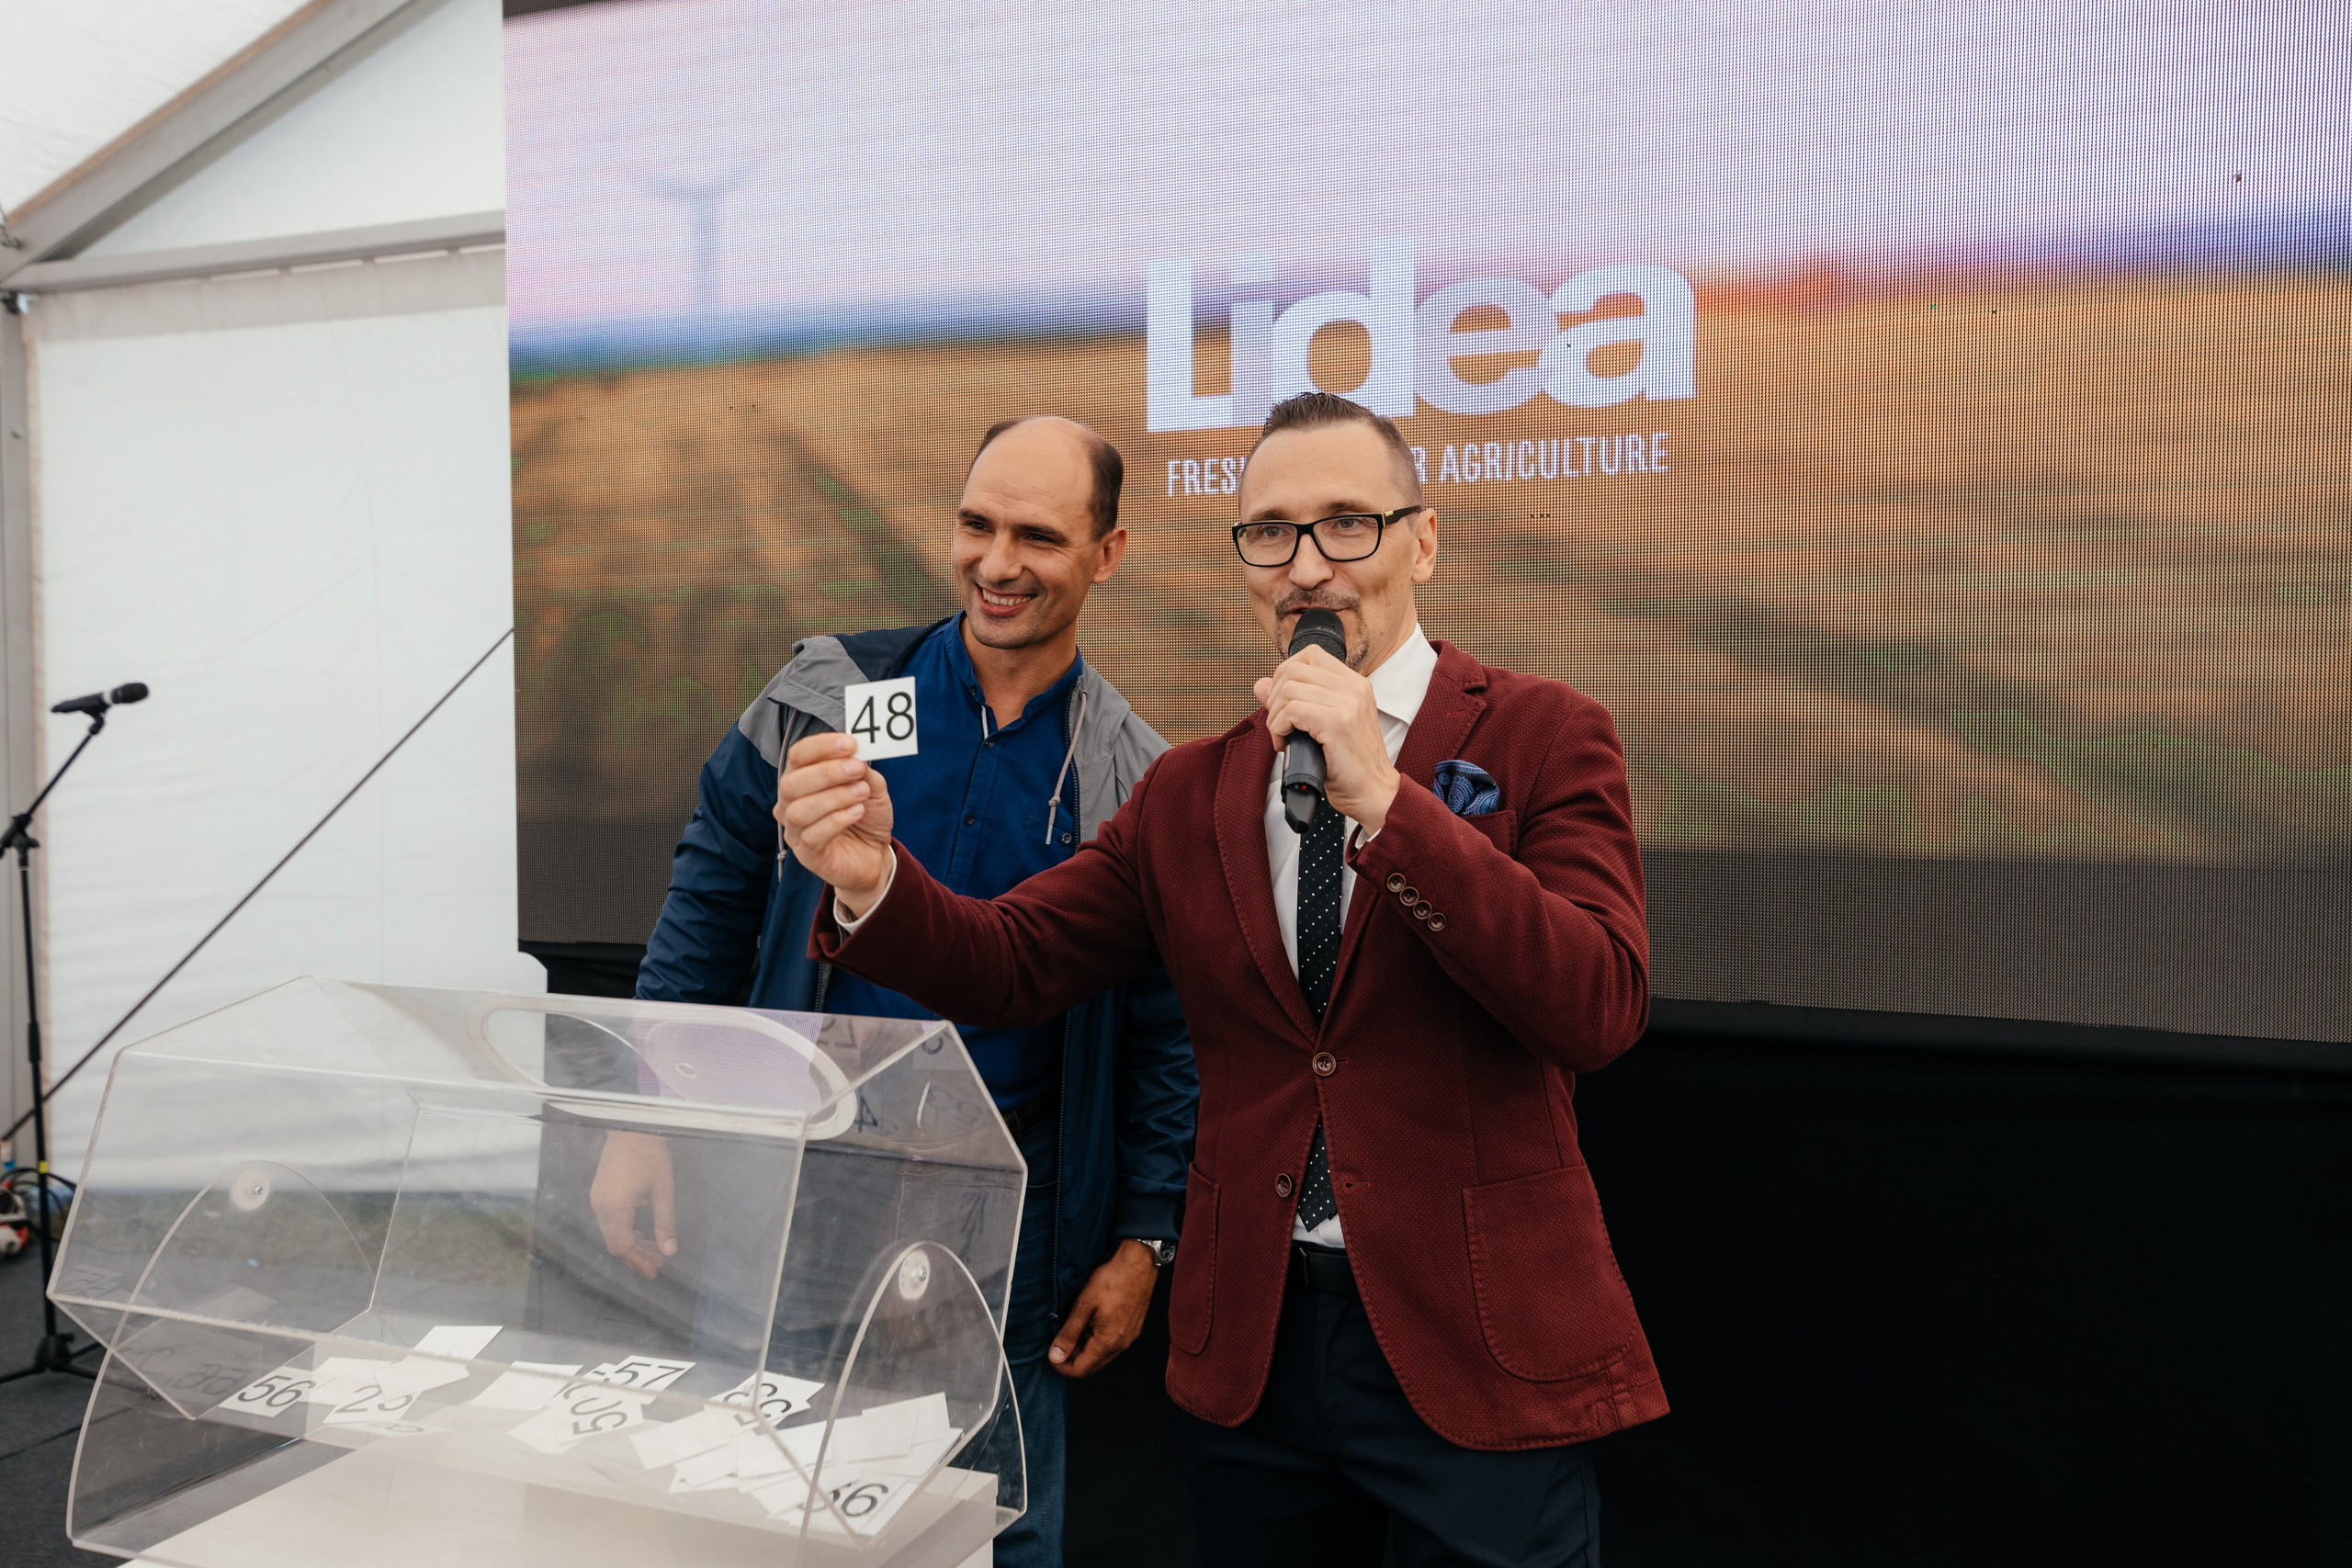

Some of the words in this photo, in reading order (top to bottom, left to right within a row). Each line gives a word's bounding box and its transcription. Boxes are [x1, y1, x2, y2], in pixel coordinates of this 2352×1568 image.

[1147, 234, 1695, 432] Lidea
[1439, 433, 1669, 483] AGRICULTURE
[851, 692, 914, 743] 48
[238, 1375, 316, 1407] 56
